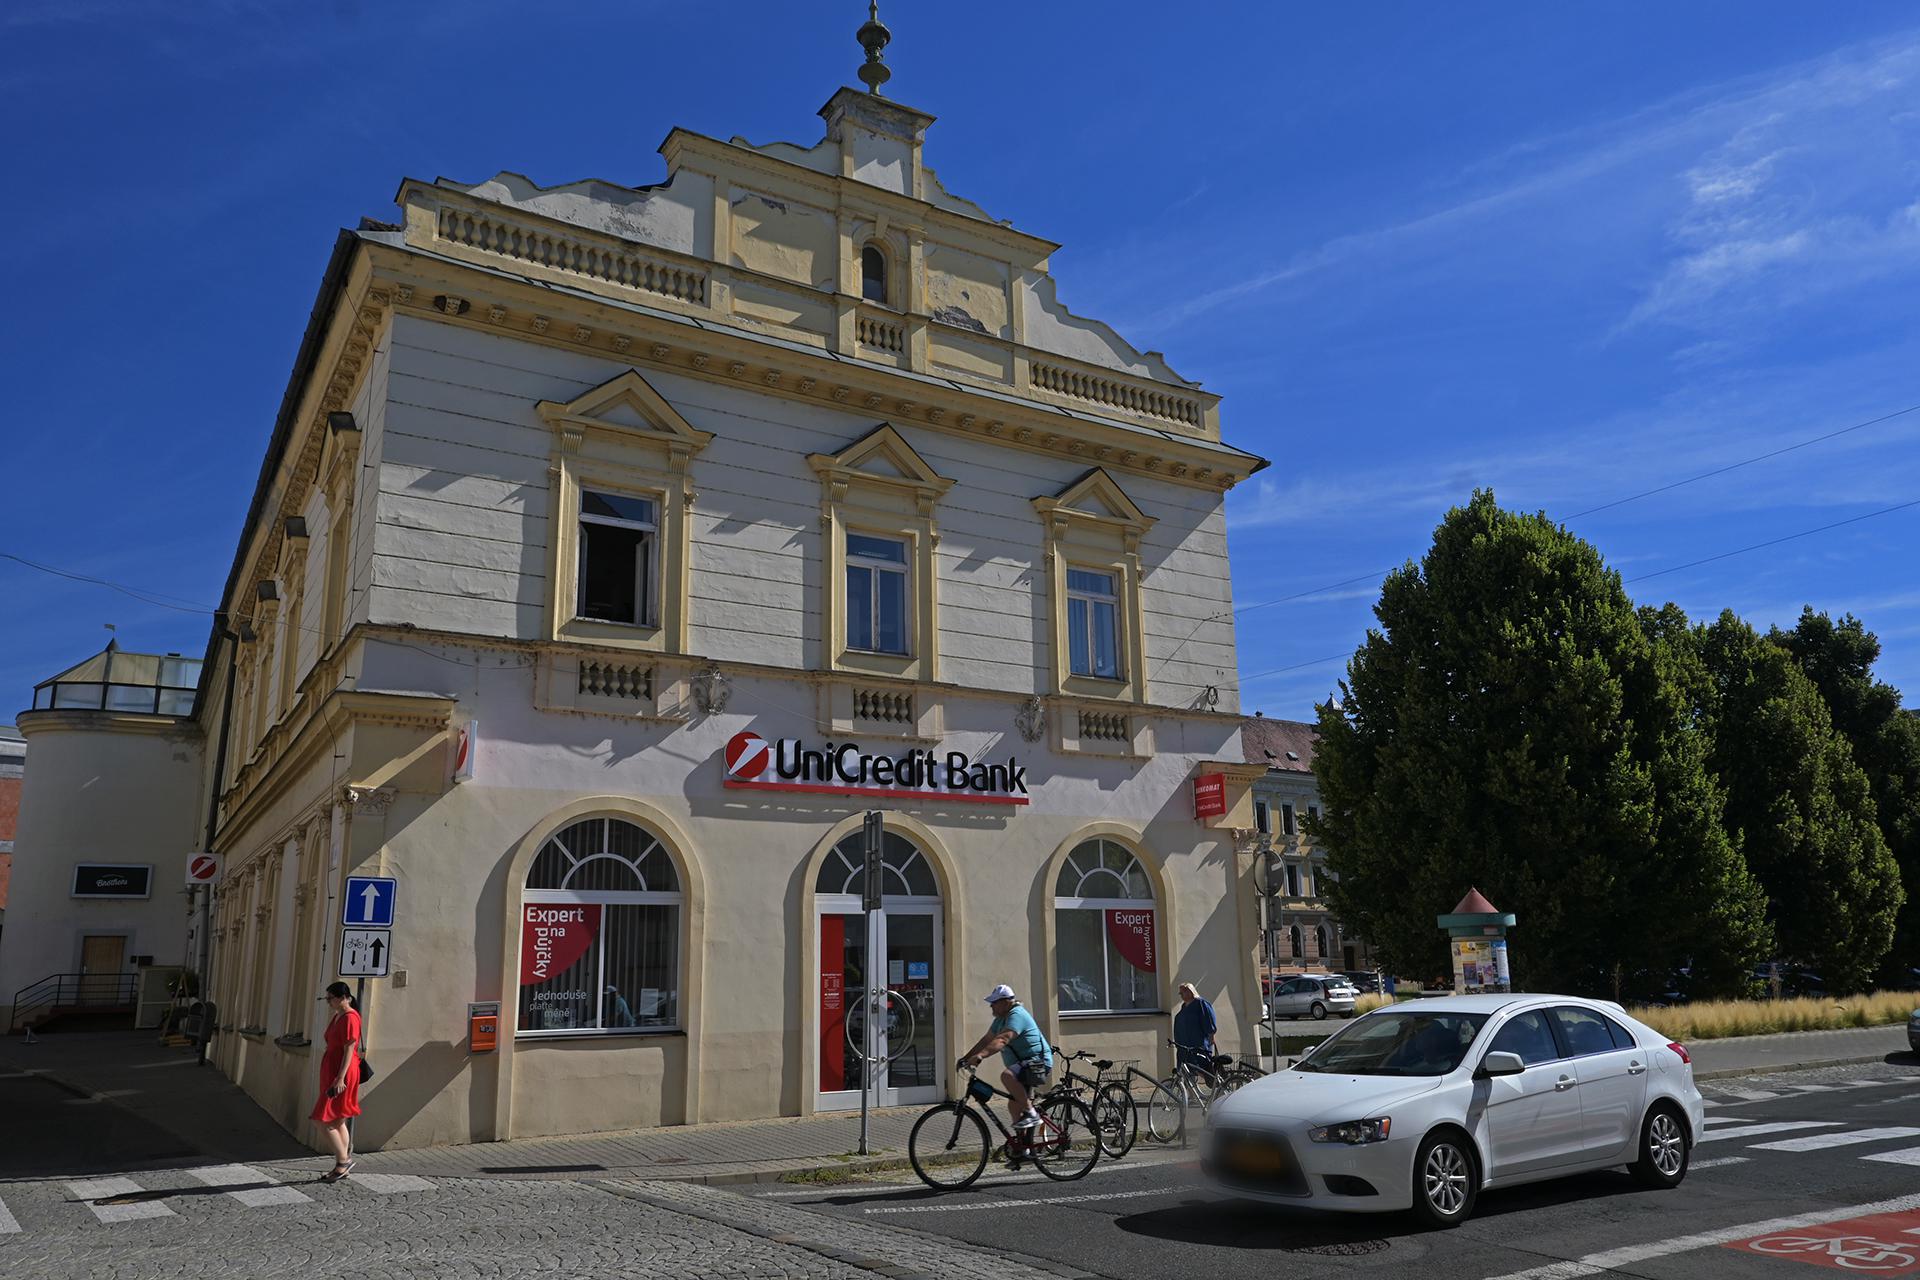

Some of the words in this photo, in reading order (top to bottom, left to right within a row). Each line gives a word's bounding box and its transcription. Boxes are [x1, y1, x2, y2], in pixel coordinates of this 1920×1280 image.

[775, 738, 937, 788] UniCredit
[946, 752, 1028, 793] Bank
[527, 907, 584, 926] Expert
[1115, 911, 1151, 927] Expert
[550, 927, 566, 937] na
[1133, 926, 1143, 934] na
[532, 927, 552, 978] půjčky
[1143, 926, 1152, 967] hypotéky
[533, 989, 587, 1001] Jednoduše
[544, 1007, 570, 1017] méně
